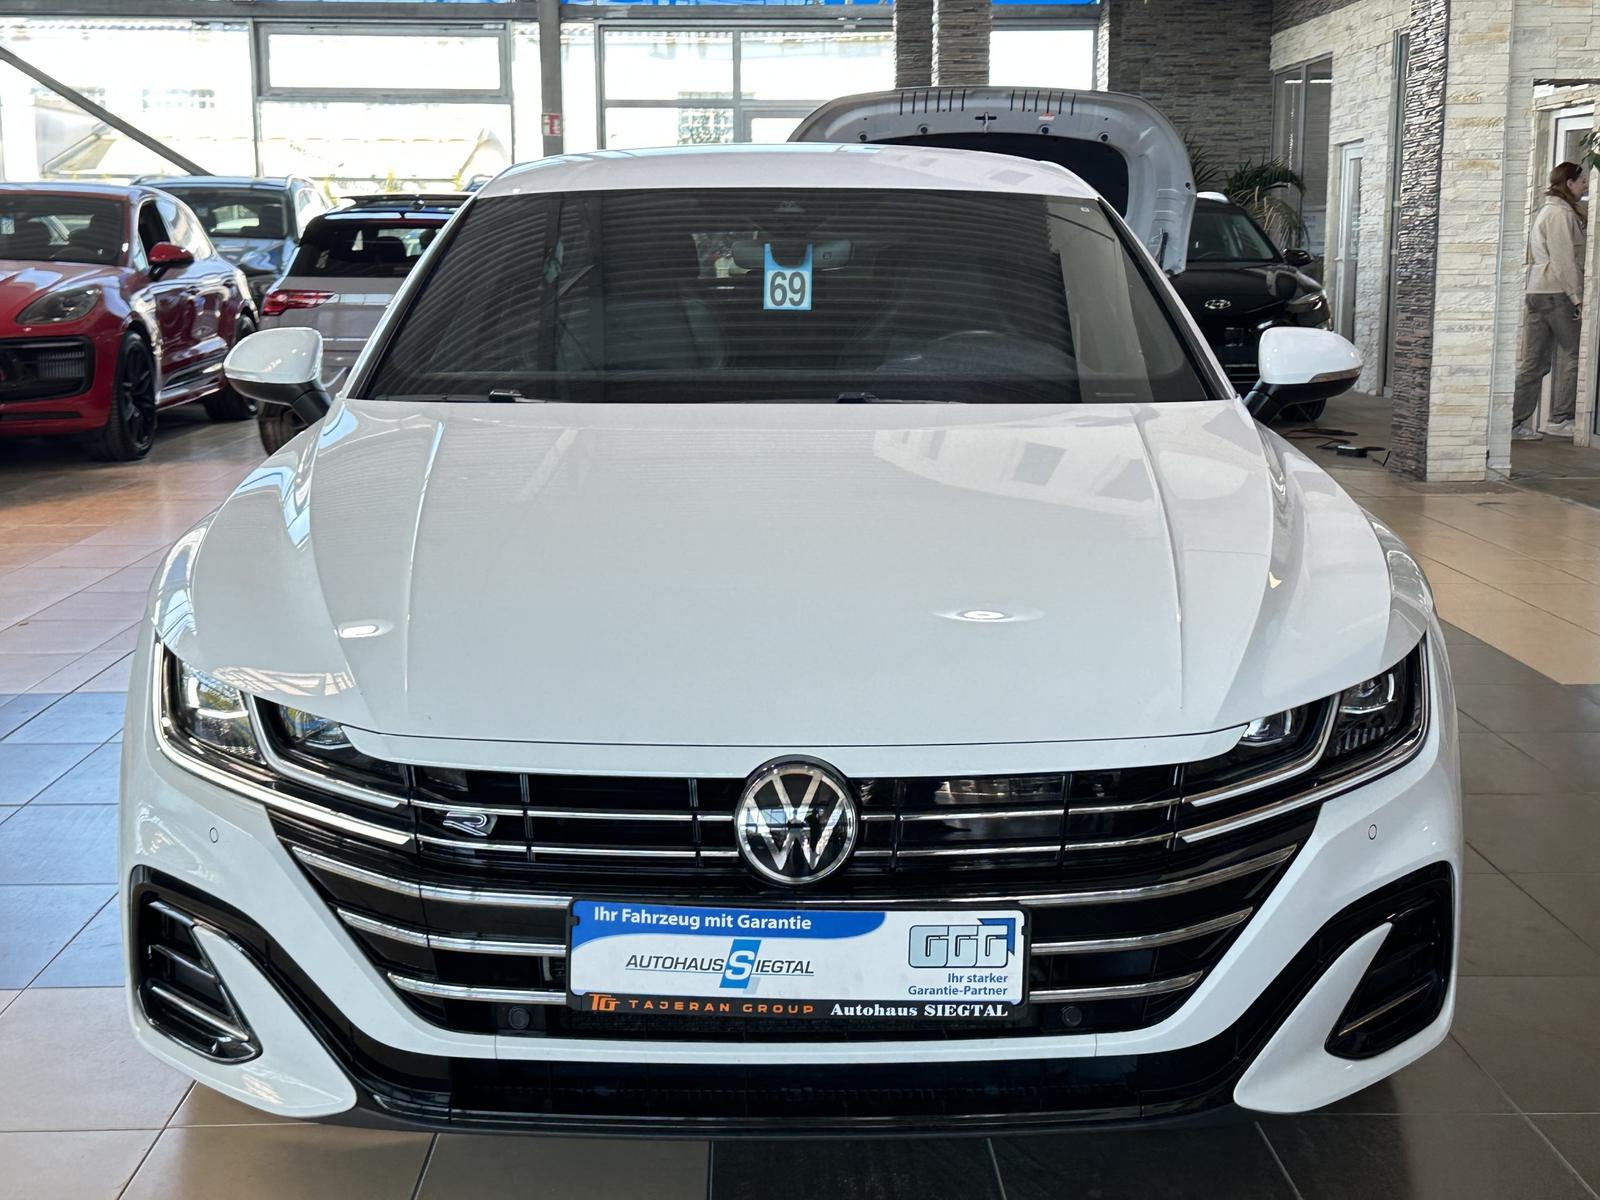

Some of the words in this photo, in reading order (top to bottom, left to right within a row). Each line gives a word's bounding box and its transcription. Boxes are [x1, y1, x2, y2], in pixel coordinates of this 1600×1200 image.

[769, 271, 806, 307] 69
[739, 765, 853, 880] VW
[594, 906, 618, 922] Ihr
[621, 908, 700, 930] Fahrzeug
[704, 913, 734, 928] mit
[737, 914, 812, 930] Garantie
[947, 973, 965, 983] Ihr
[966, 972, 1009, 983] starker
[907, 985, 1008, 996] Garantie-Partner
[629, 1000, 730, 1013] TAJERAN
[742, 1003, 815, 1015] GROUP
[830, 1003, 918, 1017] Autohaus
[923, 1004, 1009, 1017] SIEGTAL
